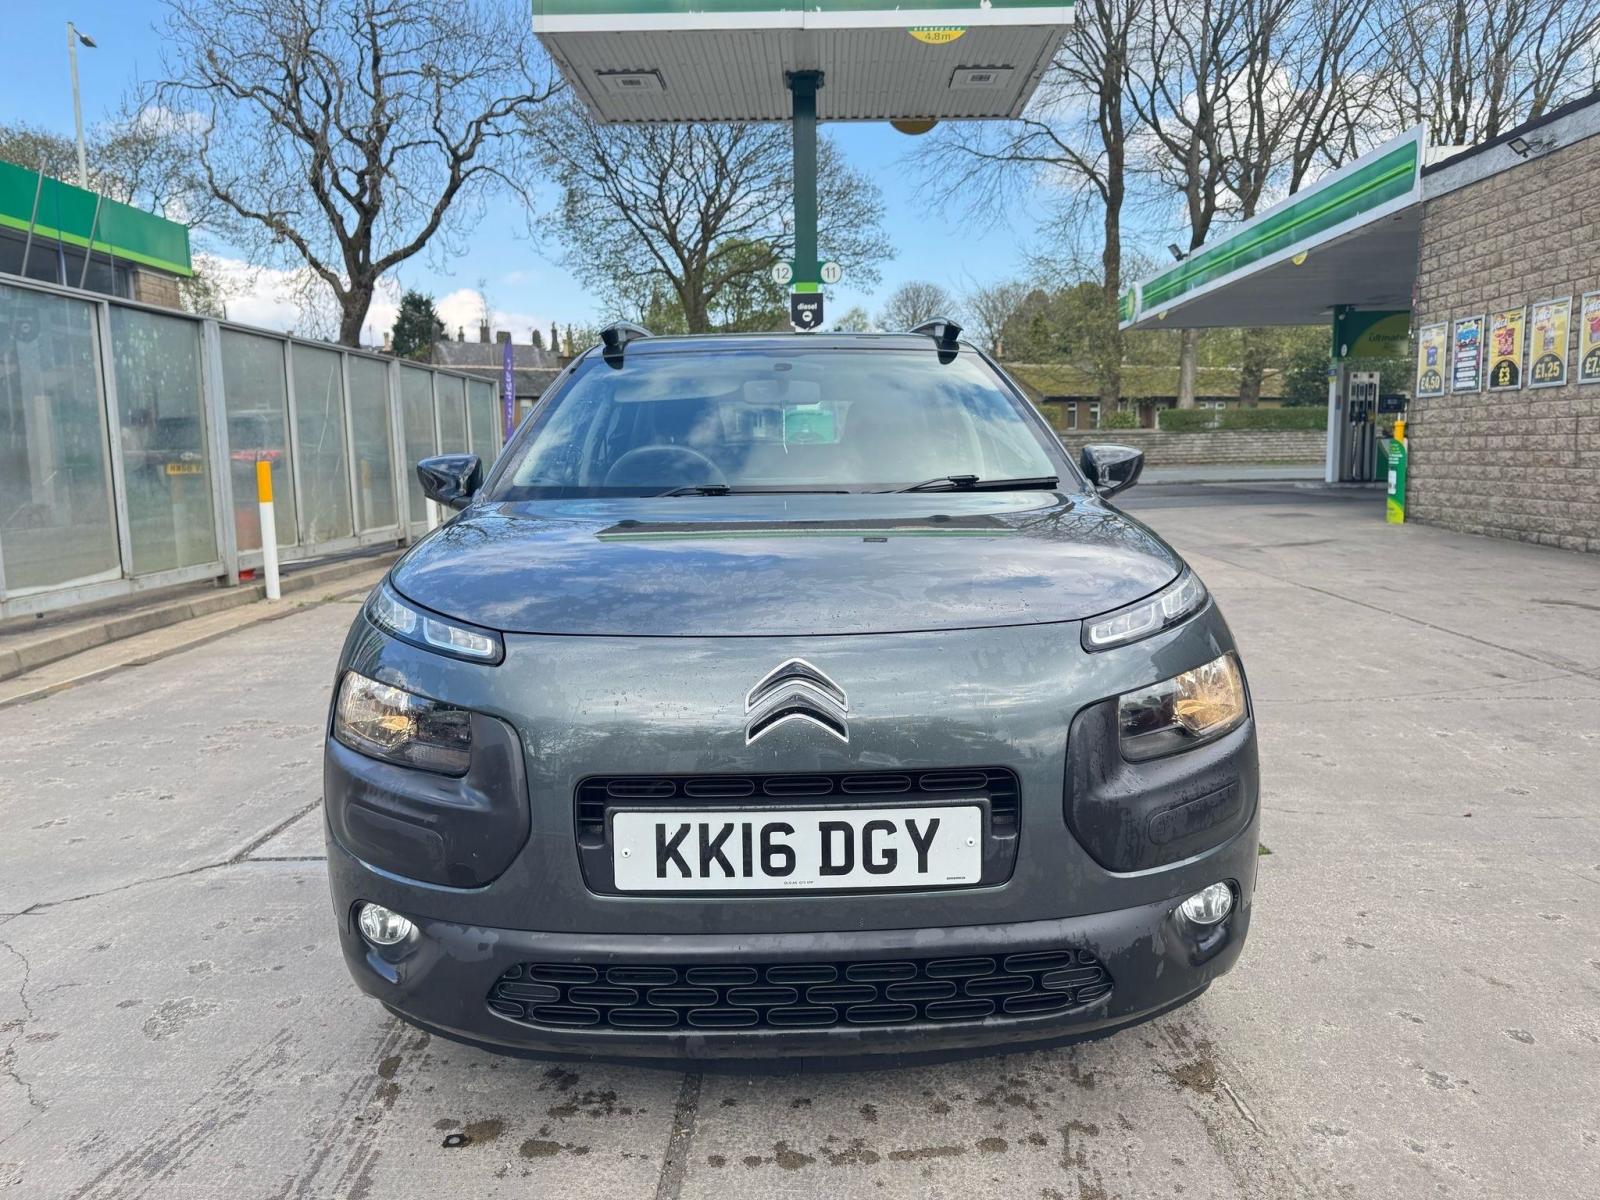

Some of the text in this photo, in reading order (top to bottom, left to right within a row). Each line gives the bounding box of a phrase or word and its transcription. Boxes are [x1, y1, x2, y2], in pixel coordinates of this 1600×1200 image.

[775, 268, 789, 279] 12
[825, 267, 836, 279] 11
[1535, 361, 1560, 379] £1.25
[1585, 357, 1600, 374] £7.
[1420, 375, 1440, 390] £4.50
[1499, 367, 1510, 383] £3
[655, 818, 941, 878] KK16 DGY
